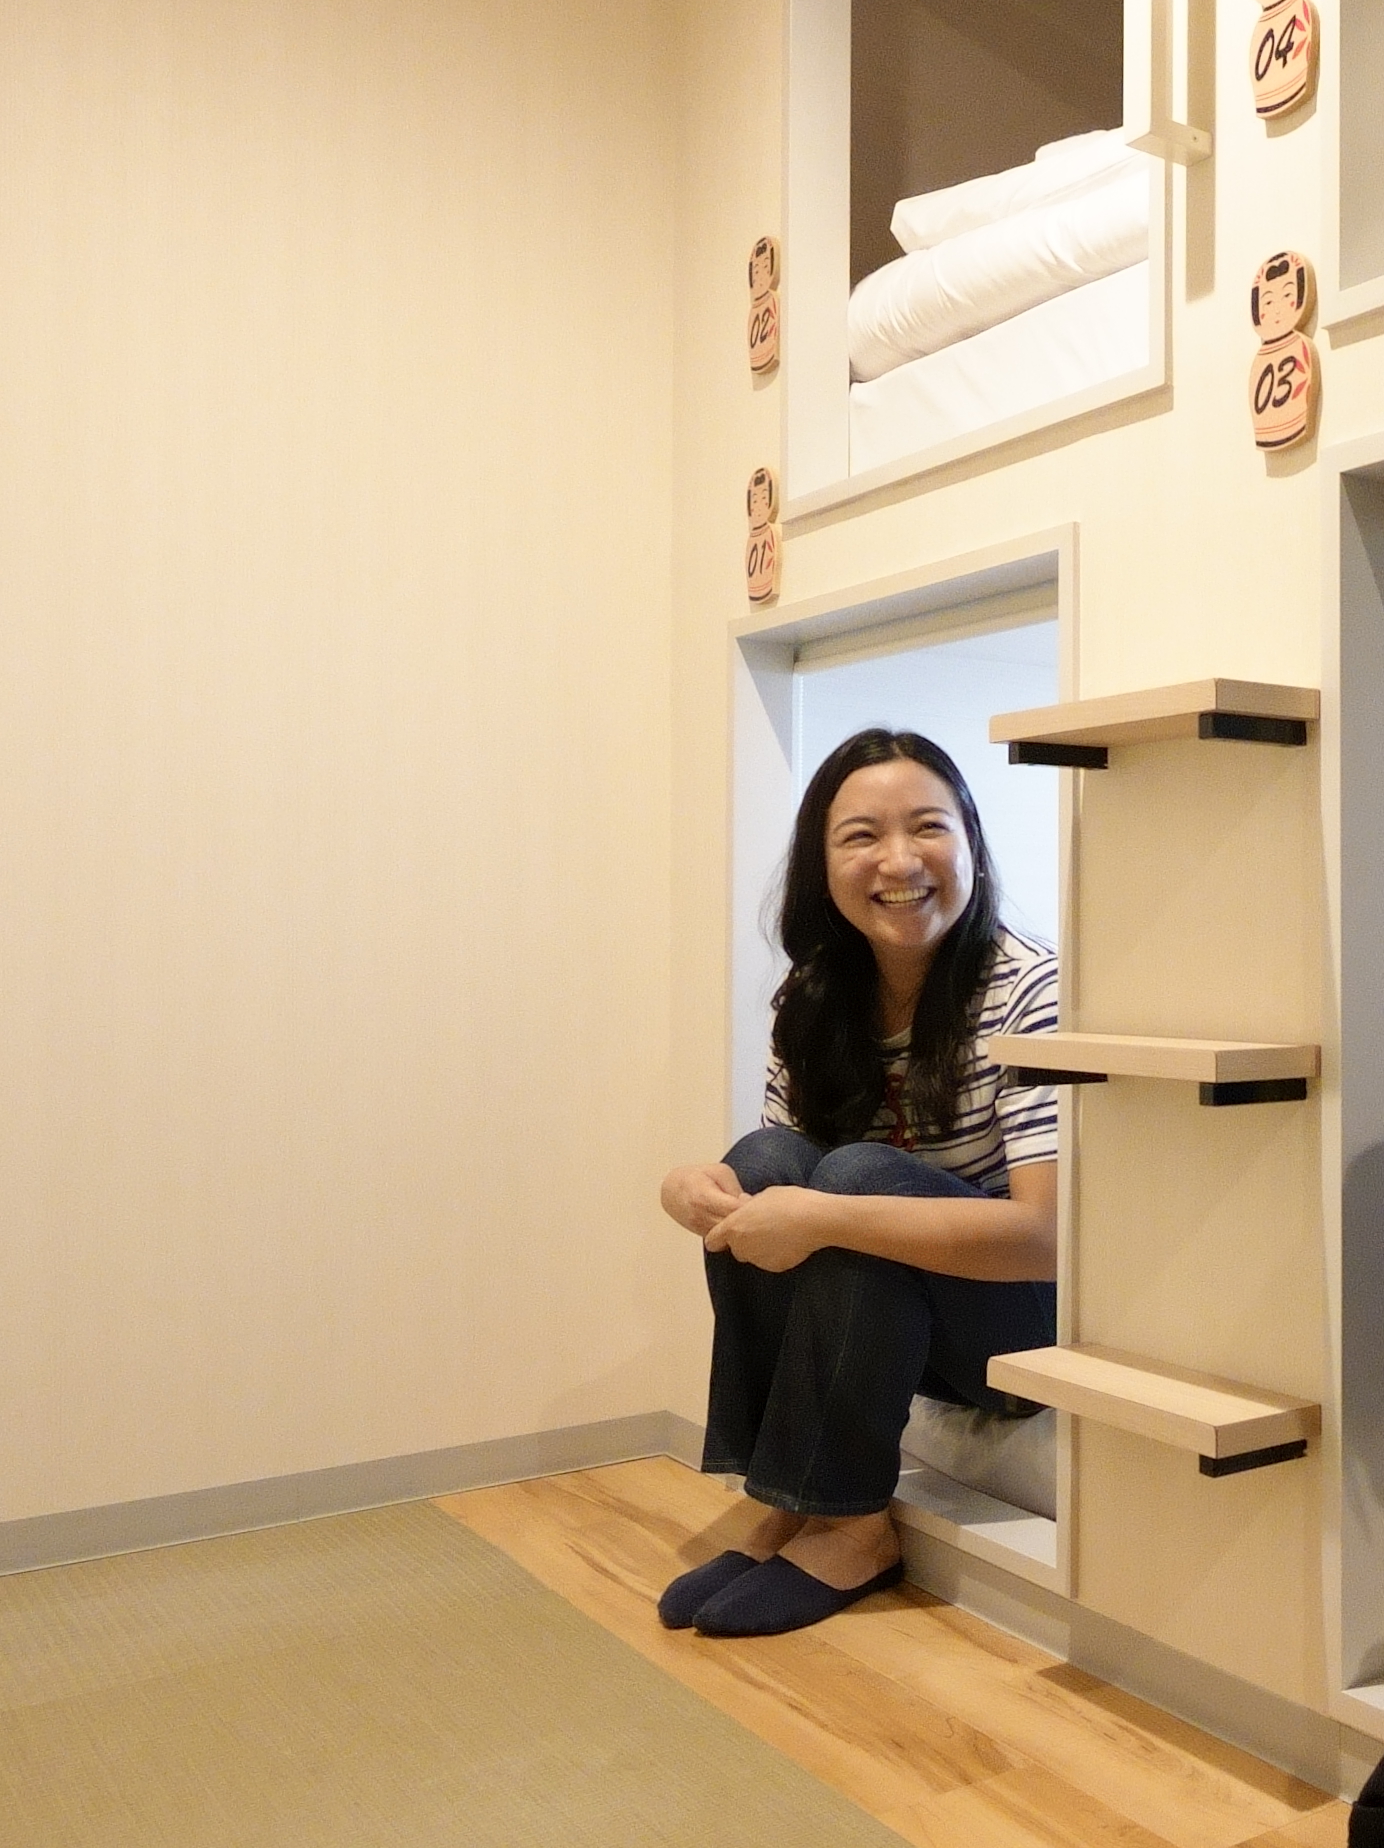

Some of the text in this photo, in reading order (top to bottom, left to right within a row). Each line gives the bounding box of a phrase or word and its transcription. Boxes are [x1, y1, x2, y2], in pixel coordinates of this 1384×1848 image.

[1255, 14, 1296, 82] 04
[750, 306, 770, 349] 02
[1254, 355, 1297, 415] 03
[748, 539, 767, 578] 01
